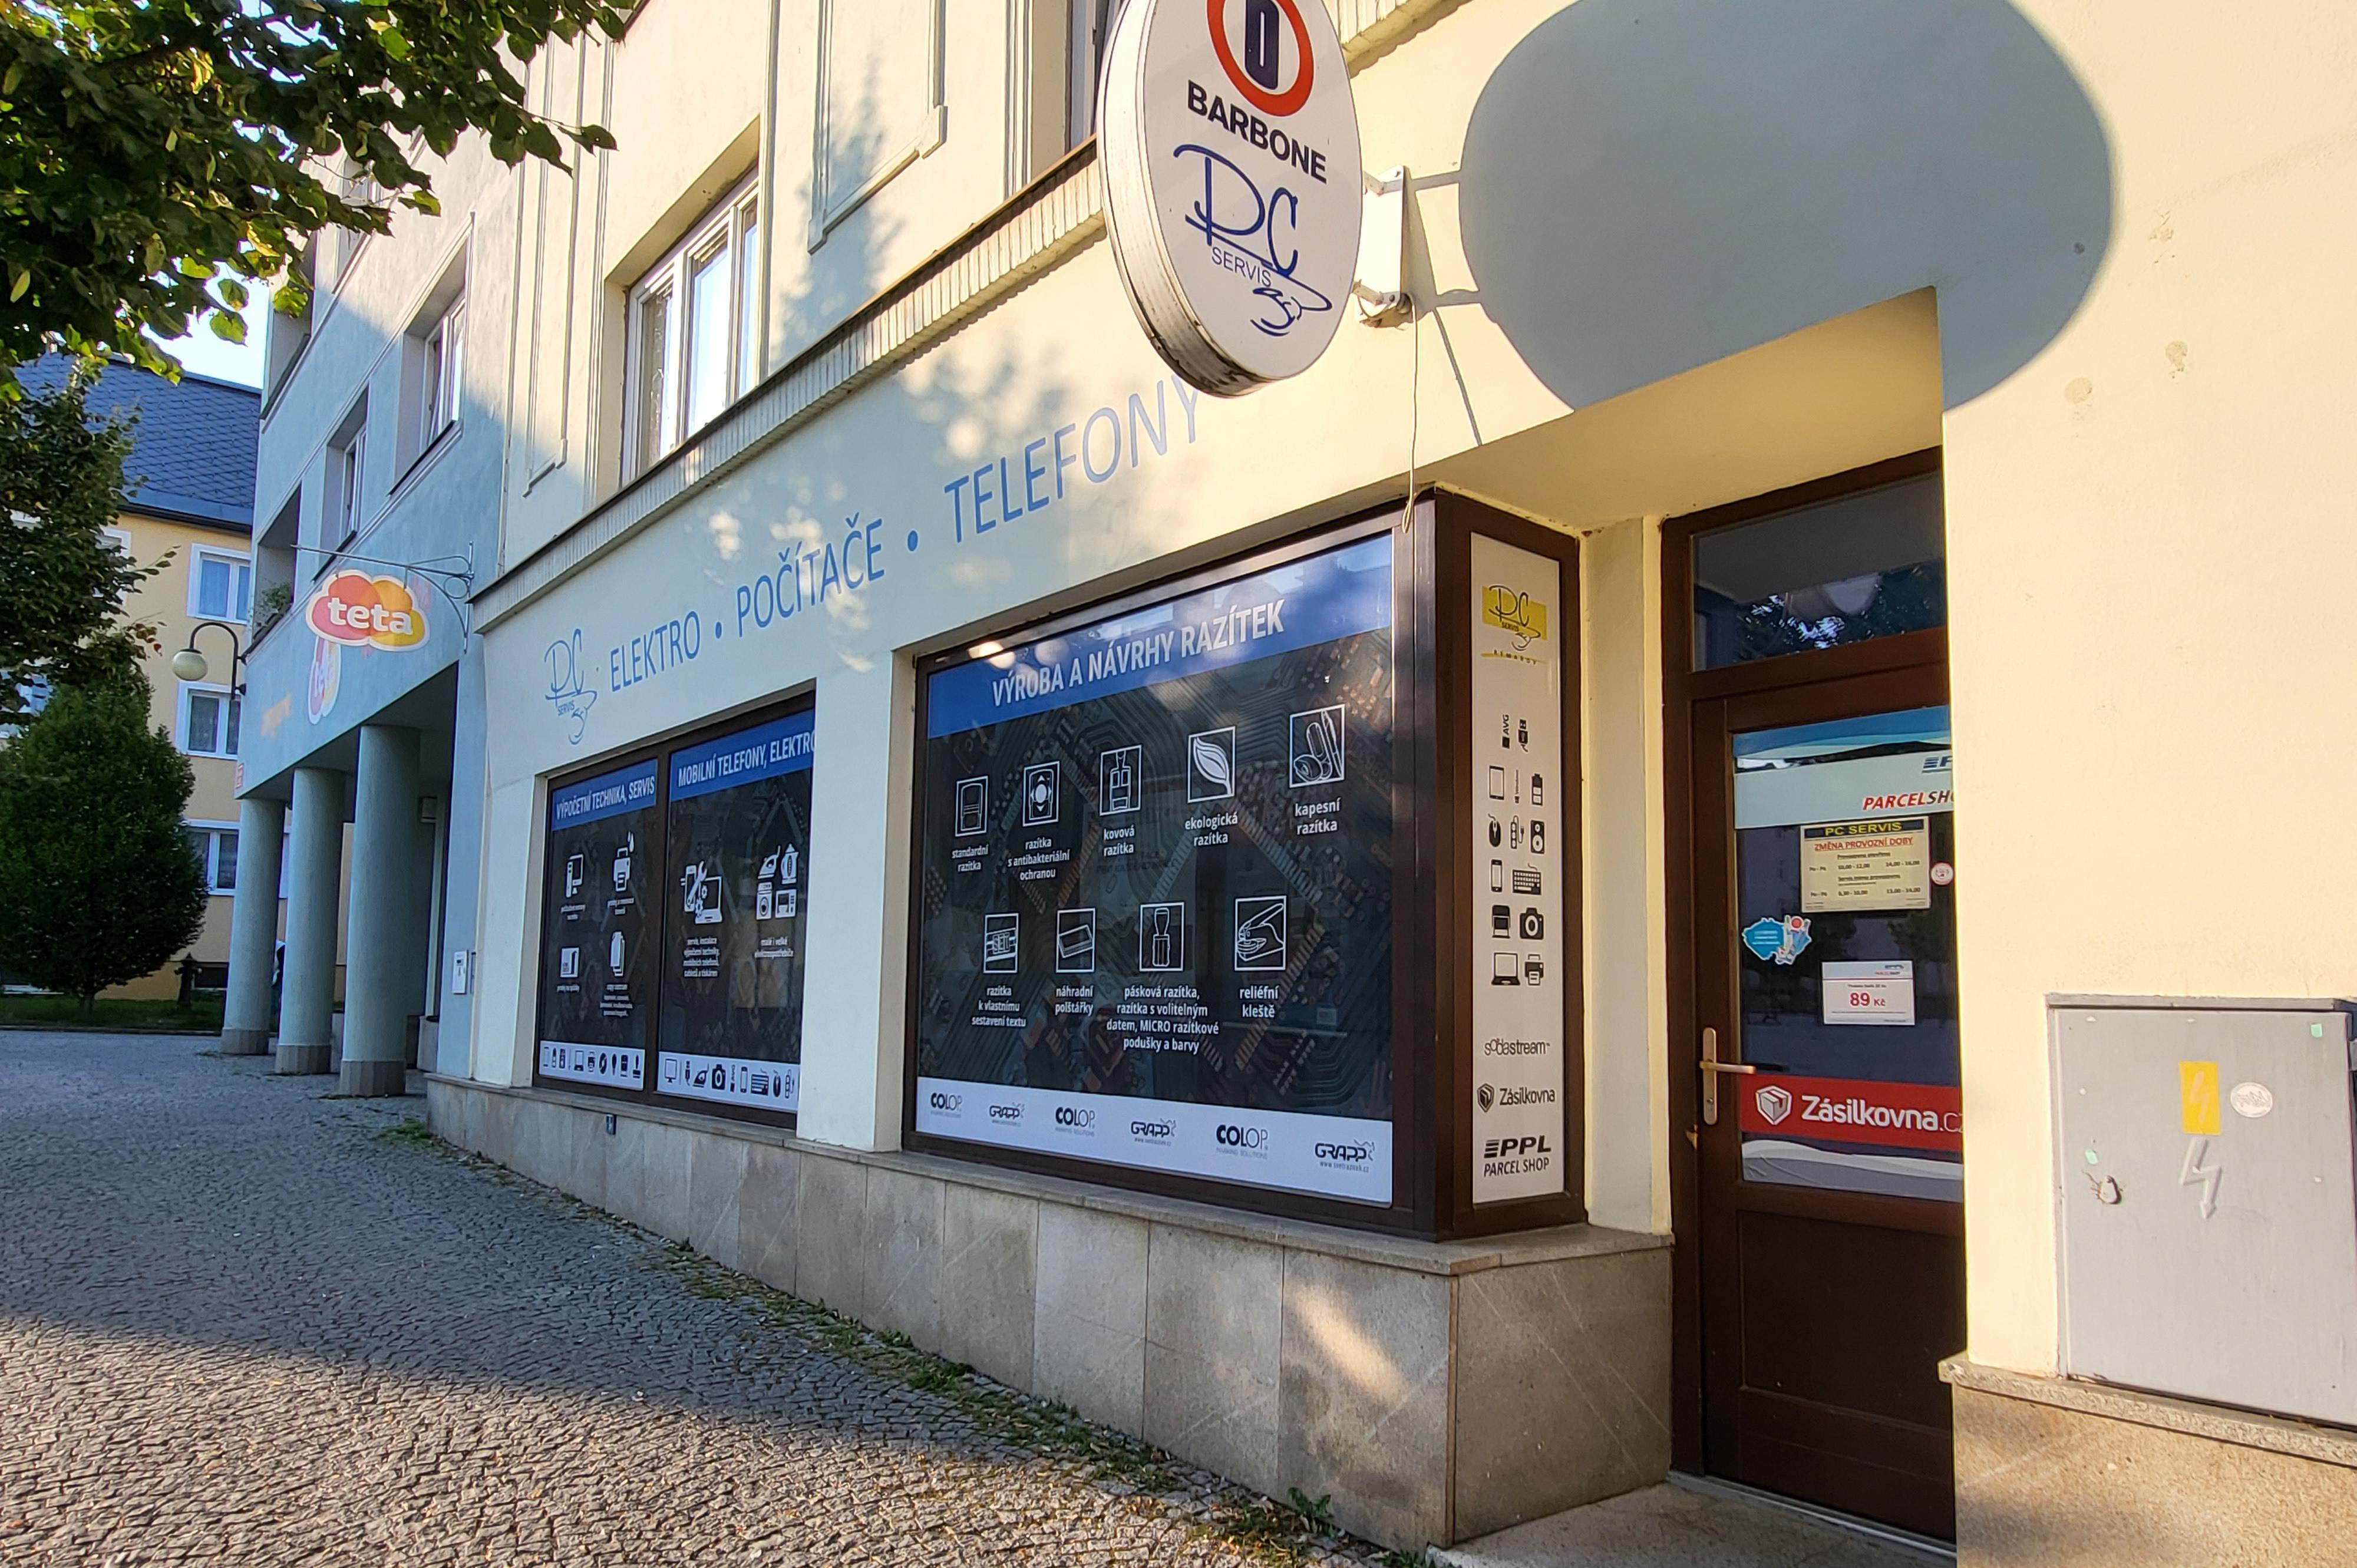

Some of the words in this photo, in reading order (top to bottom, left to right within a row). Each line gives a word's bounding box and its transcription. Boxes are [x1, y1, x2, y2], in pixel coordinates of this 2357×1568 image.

[1188, 80, 1328, 184] BARBONE
[1173, 144, 1298, 278] PC
[1211, 246, 1272, 287] SERVIS
[610, 611, 701, 692] ELEKTRO
[737, 511, 884, 638] POČÍTAČE
[944, 373, 1199, 543] TELEFONY
[328, 597, 414, 635] teta
[993, 662, 1065, 707] VÝROBA
[1069, 658, 1083, 687] A
[1088, 630, 1174, 682] NÁVRHY
[1181, 599, 1286, 658] RAZÍTEK
[678, 753, 716, 787] MOBILNÍ
[717, 744, 767, 777] TELEFONY,
[556, 790, 592, 820] VÝPOČETNÍ
[592, 784, 627, 811] TECHNIKA,
[628, 775, 655, 800] SERVIS
[1295, 797, 1341, 816] kapesní
[1185, 811, 1238, 830] ekologická
[1296, 820, 1338, 835] razítka
[1103, 825, 1135, 841] kovová
[1825, 827, 1845, 836] PC
[1848, 823, 1902, 834] SERVIS
[1025, 837, 1052, 850] razítka
[1194, 831, 1229, 846] razítka
[1815, 841, 1843, 851] ZMĚNA
[1845, 837, 1887, 849] PROVOZNÍ
[1889, 837, 1914, 846] DOBY
[952, 844, 989, 859] standardní
[1103, 842, 1134, 857] razítka
[958, 860, 981, 872] razítka
[1008, 859, 1012, 867] s
[1013, 849, 1071, 866] antibakteriální
[1020, 869, 1056, 880] ochranou
[986, 985, 1012, 996] razítka
[1056, 985, 1094, 997] náhradní
[1124, 985, 1161, 1000] pásková
[1163, 985, 1200, 1000] razítka,
[1239, 985, 1279, 999] reliéfní
[978, 1000, 983, 1010] k
[984, 1000, 1020, 1011] vlastnímu
[1850, 992, 1870, 1006] 89
[1873, 998, 1886, 1006] Kč
[1055, 1001, 1094, 1016] polštářky
[1117, 1002, 1147, 1014] razítka
[1150, 1005, 1155, 1015] s
[1157, 1003, 1208, 1019] volitelným
[1242, 1003, 1275, 1018] kleště
[972, 1015, 1006, 1026] sestavení
[1006, 1017, 1026, 1027] textu
[1106, 1019, 1138, 1032] datem,
[1140, 1020, 1171, 1032] MICRO
[1173, 1021, 1219, 1034] razítkové
[1123, 1036, 1162, 1052] podušky
[1163, 1040, 1170, 1049] a
[1171, 1037, 1200, 1055] barvy
[930, 1092, 962, 1111] COLOP
[1499, 1087, 1556, 1105] Zásilkovna
[989, 1105, 1021, 1120] GRAPP
[1055, 1107, 1096, 1128] COLOP
[1130, 1121, 1171, 1138] GRAPP
[1216, 1124, 1269, 1150] COLOP
[1315, 1142, 1367, 1163] GRAPP
[1500, 1135, 1552, 1157] PPL
[1484, 1159, 1520, 1177] PARCEL
[1523, 1157, 1550, 1173] SHOP
